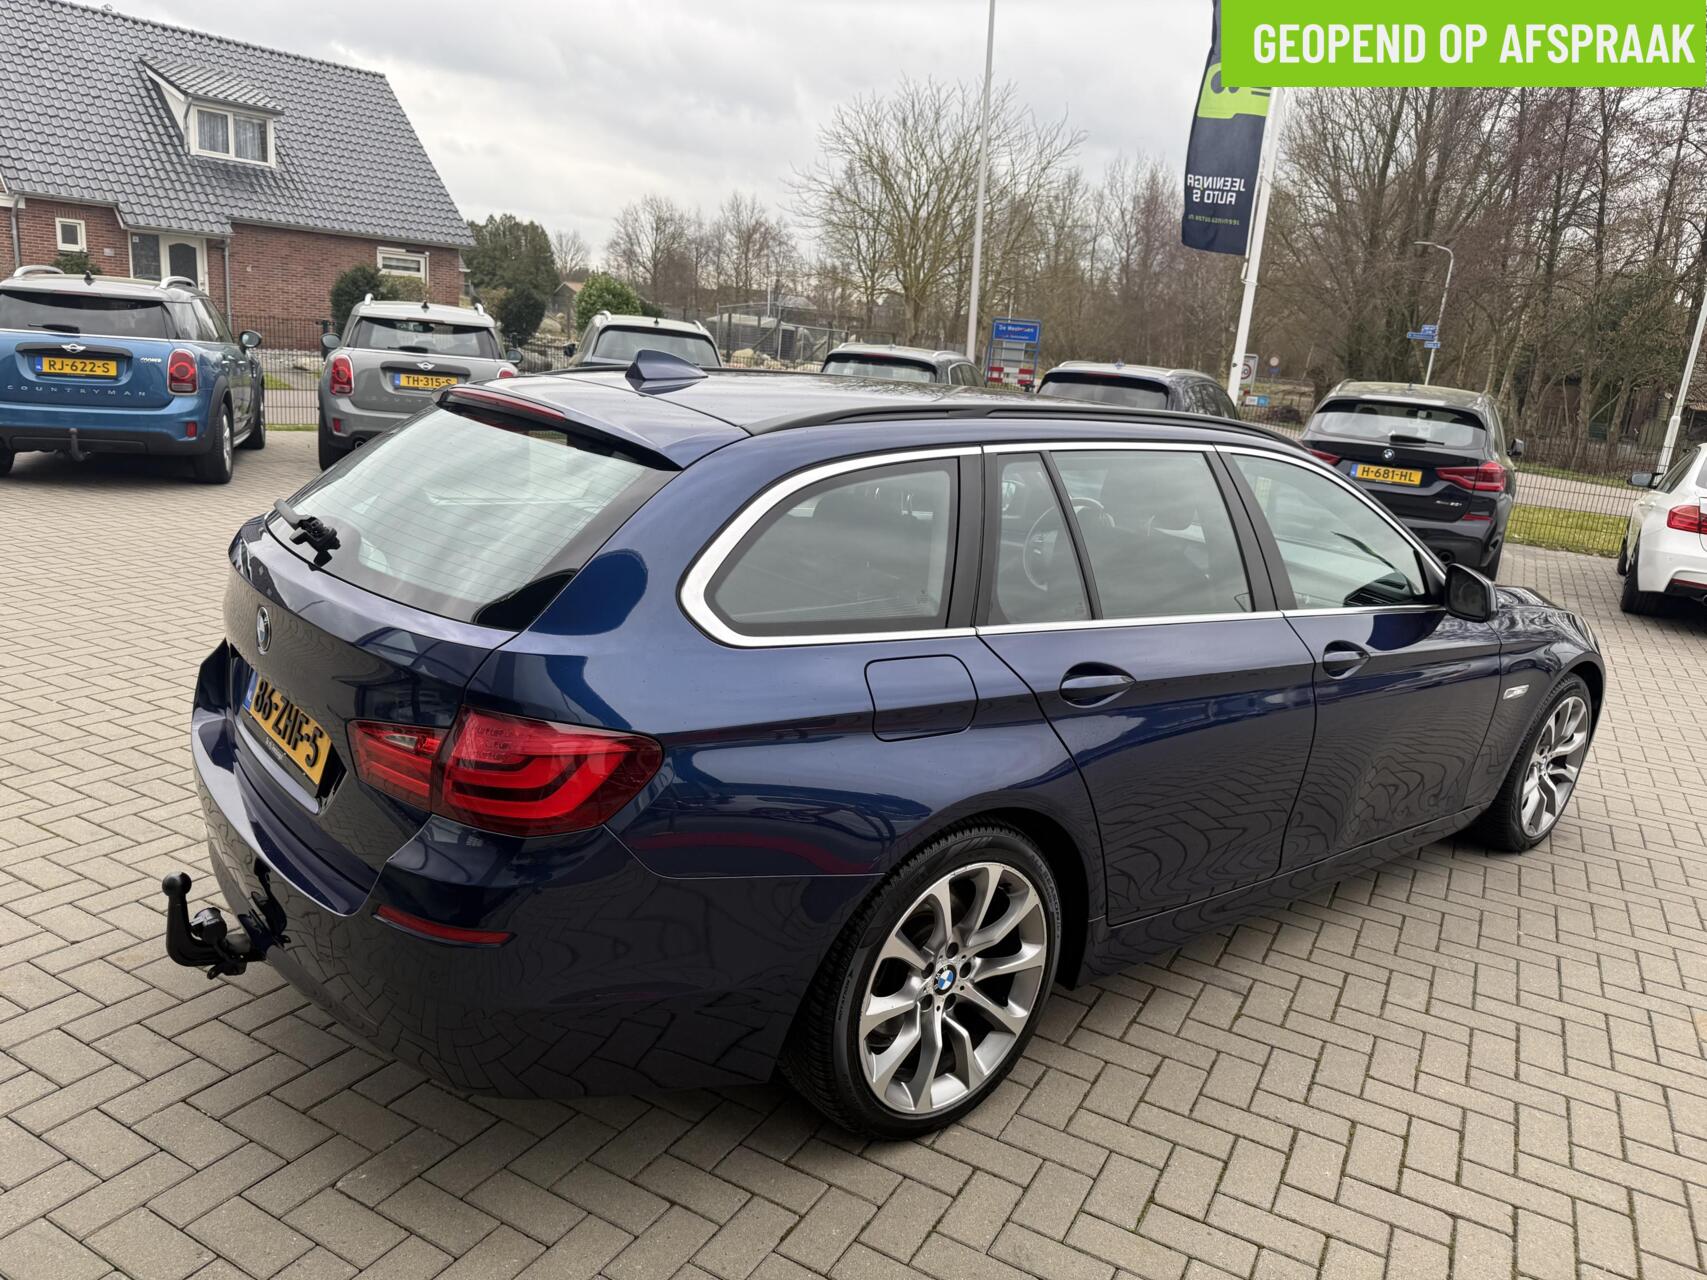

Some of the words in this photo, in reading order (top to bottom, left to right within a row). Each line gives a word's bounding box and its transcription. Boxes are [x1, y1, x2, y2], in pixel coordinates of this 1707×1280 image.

[48, 359, 110, 373] RJ-622-S
[405, 375, 452, 387] TH-315-S
[7, 384, 146, 397] COUNTRYMAN
[1361, 466, 1416, 483] H-681-HL
[253, 680, 324, 768] 86-ZHF-5
